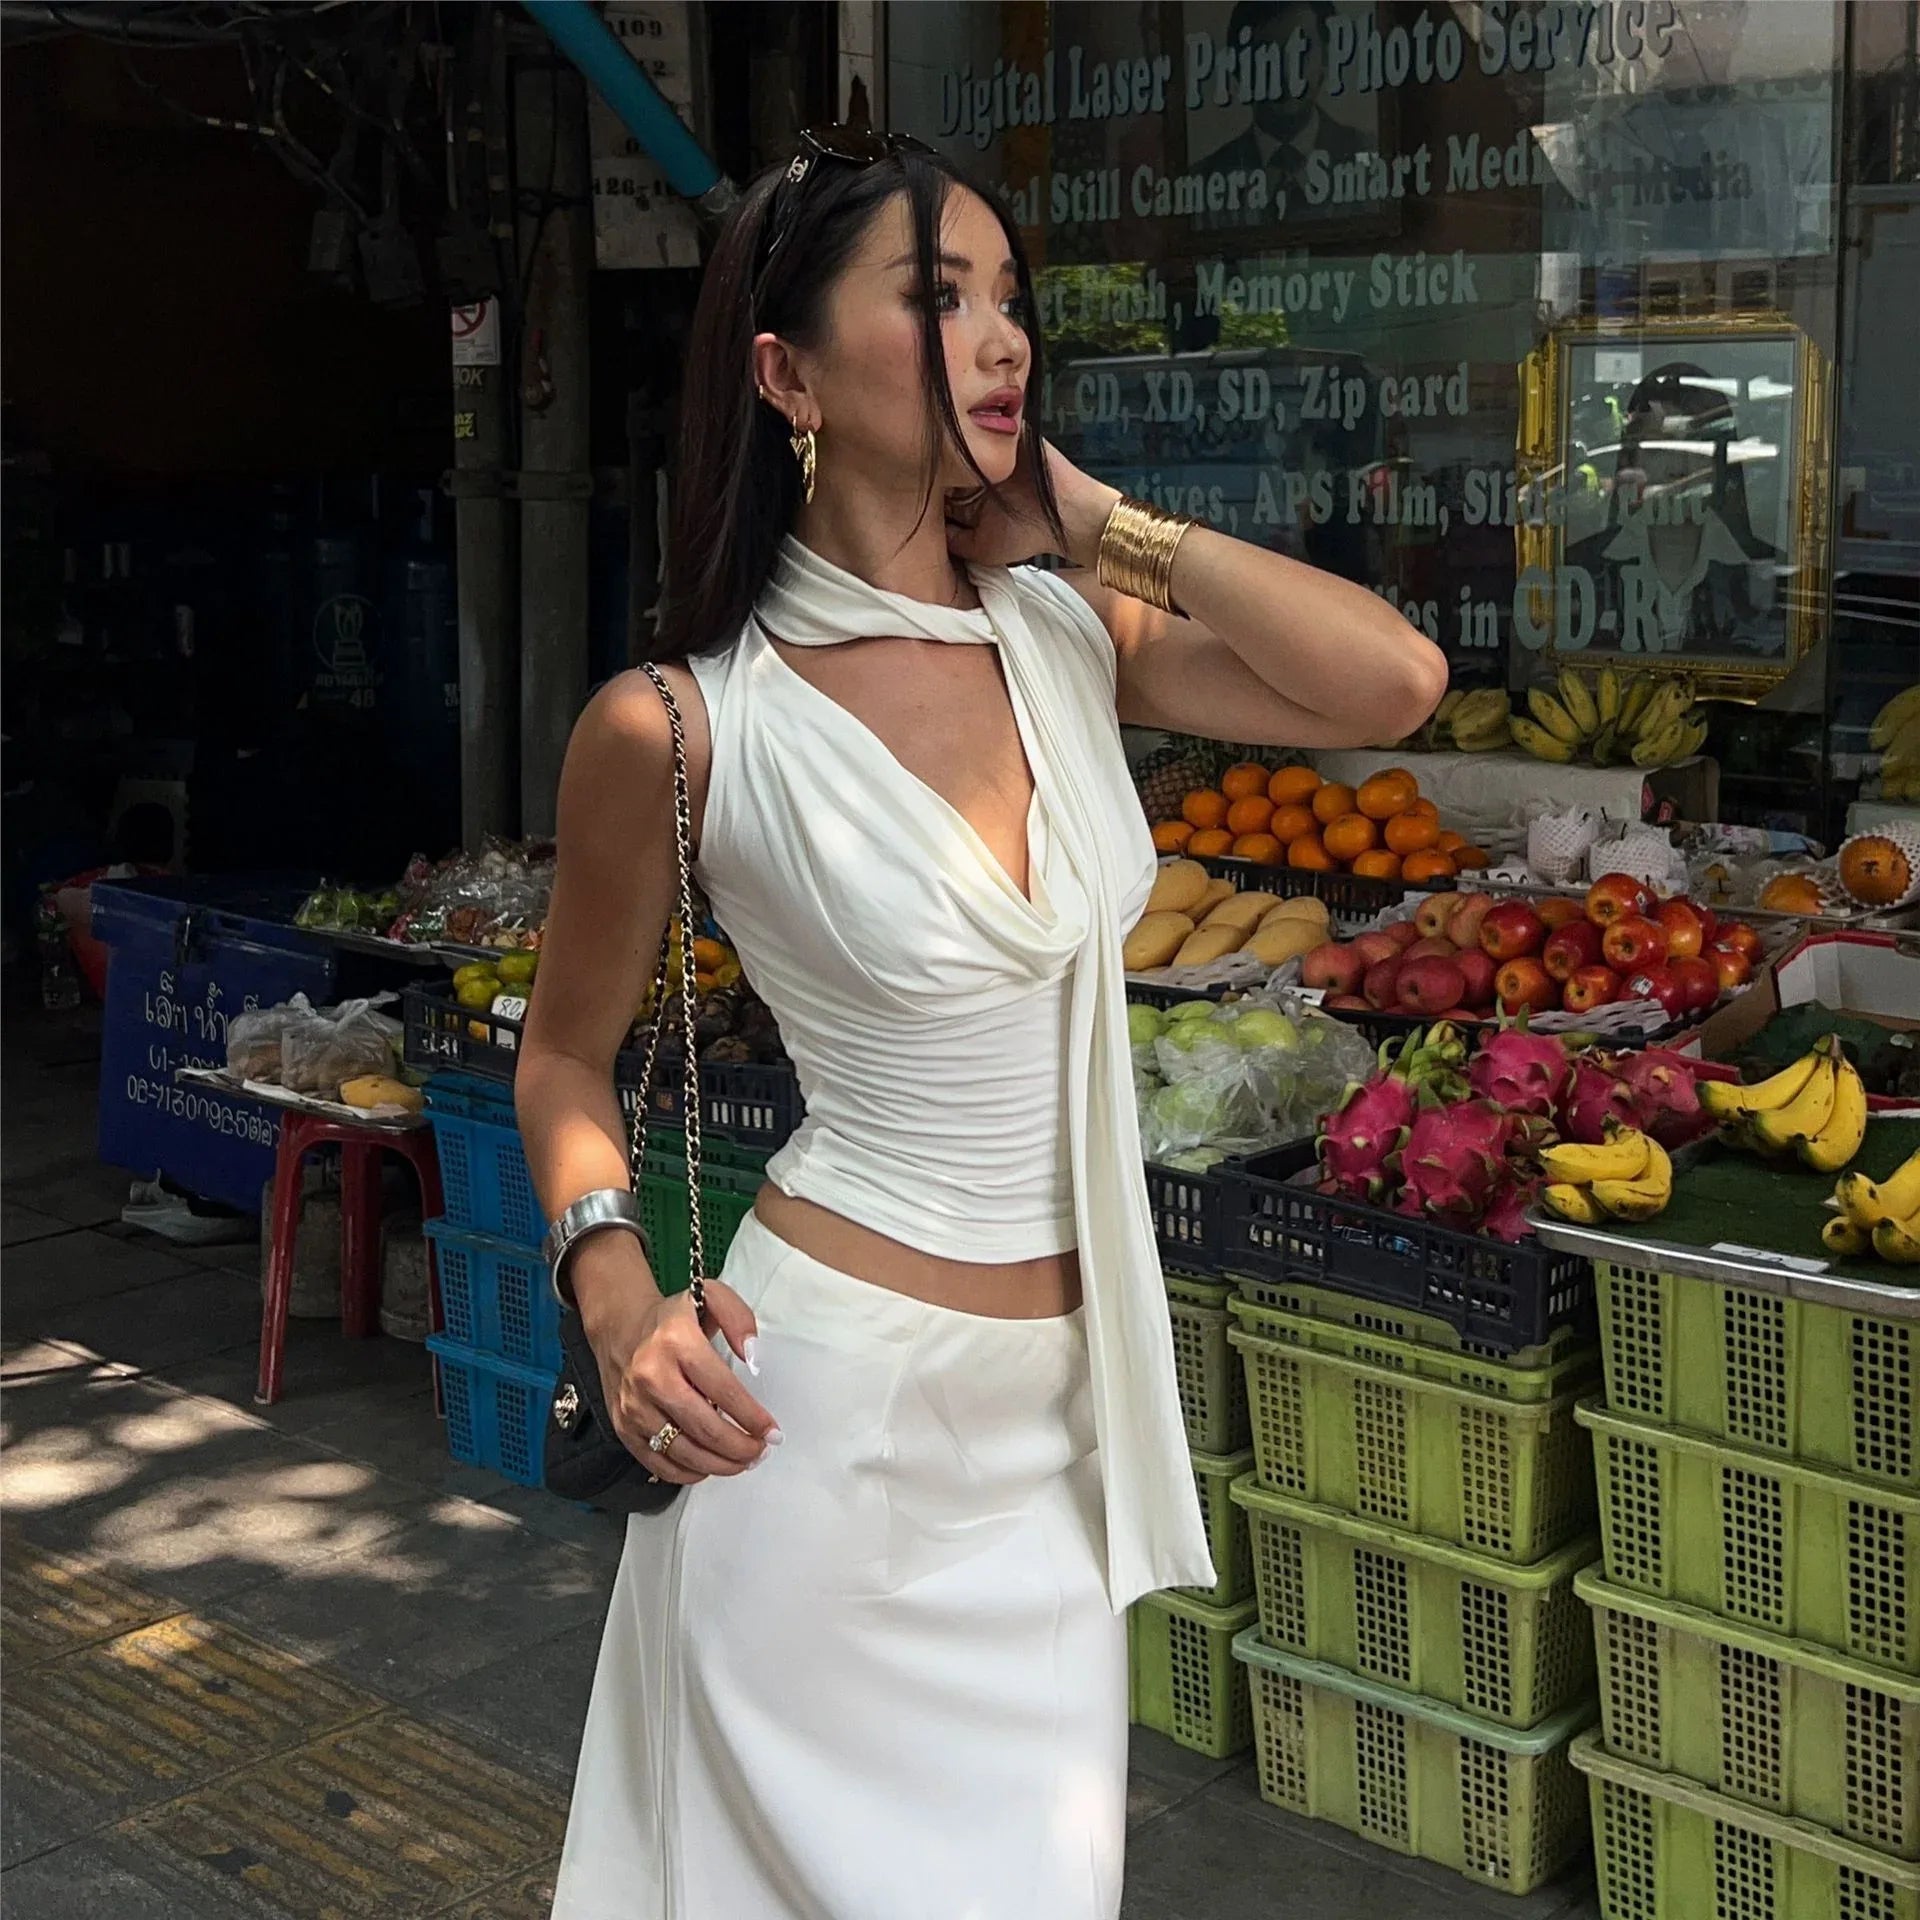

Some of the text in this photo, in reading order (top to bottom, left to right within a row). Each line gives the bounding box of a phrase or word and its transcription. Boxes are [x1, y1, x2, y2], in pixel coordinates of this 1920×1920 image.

[938, 0, 1675, 150] Digital Laser Print Photo Service
[997, 173, 1041, 226] tal
[1051, 168, 1121, 224] Still
[1305, 140, 1432, 206] Smart
[1446, 128, 1560, 194] Medi
[1195, 261, 1356, 323] Memory
[1368, 248, 1480, 309] Stick
[1074, 373, 1129, 434] CD,
[1143, 369, 1205, 433] XD,
[1217, 367, 1286, 431] SD,
[1300, 365, 1367, 430] Zip
[1379, 362, 1469, 417] card
[1121, 472, 1239, 536] tives,
[1252, 470, 1334, 526] APS
[1346, 470, 1450, 536] Film,
[1459, 584, 1499, 648] in
